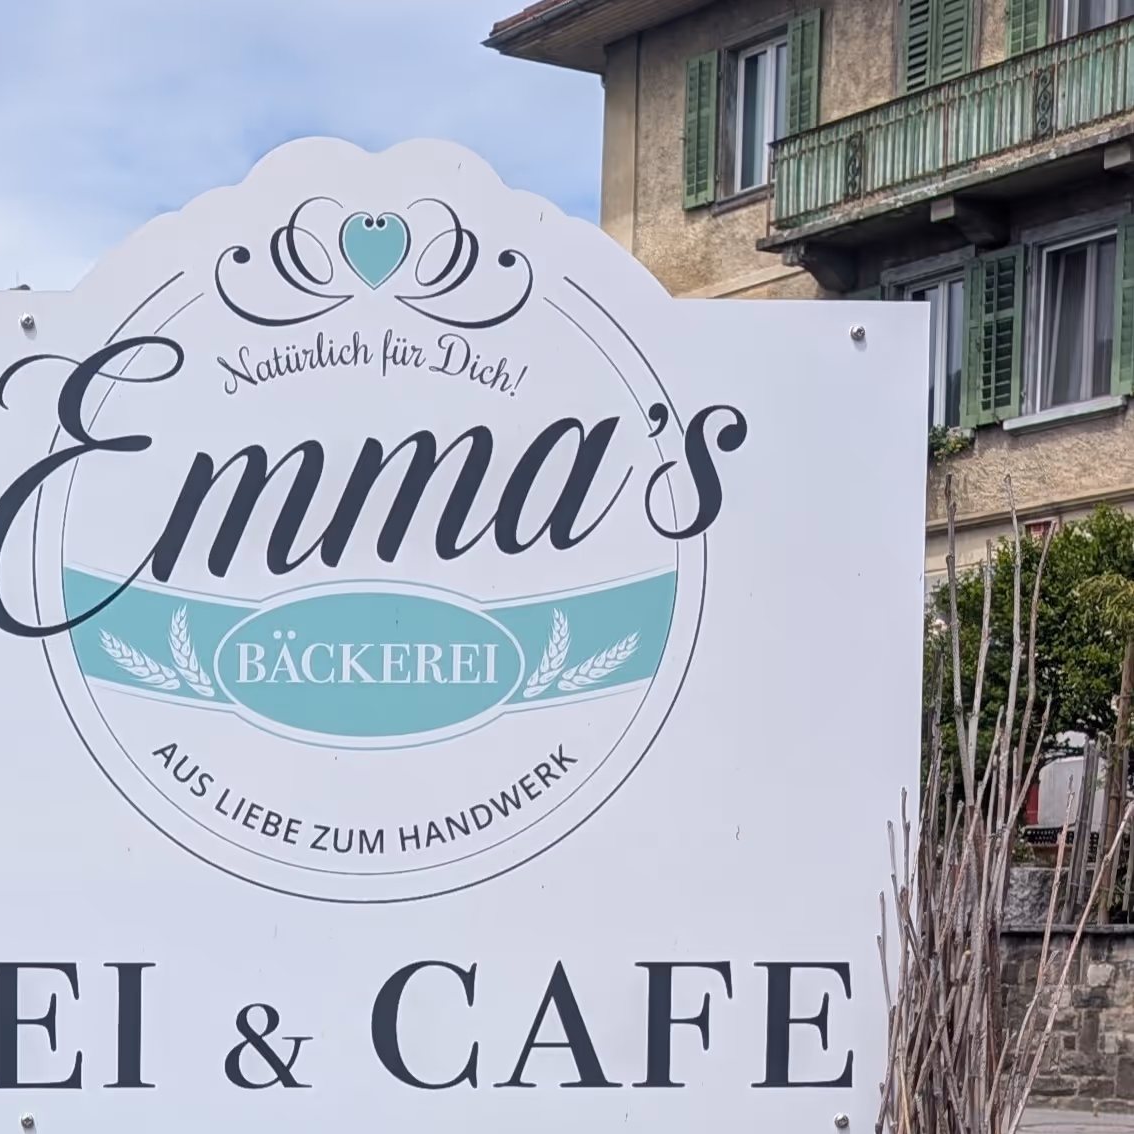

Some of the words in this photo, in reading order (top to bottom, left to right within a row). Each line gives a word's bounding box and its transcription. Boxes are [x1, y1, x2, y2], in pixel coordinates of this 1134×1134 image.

[217, 331, 373, 394] Natürlich
[382, 329, 426, 377] für
[428, 333, 528, 397] Dich!
[235, 629, 501, 686] BÄCKEREI
[151, 742, 215, 798] AUS
[214, 787, 303, 845] LIEBE
[309, 824, 385, 855] ZUM
[398, 743, 578, 853] HANDWERK
[224, 1003, 314, 1090] &
[371, 960, 854, 1090] CAFE
